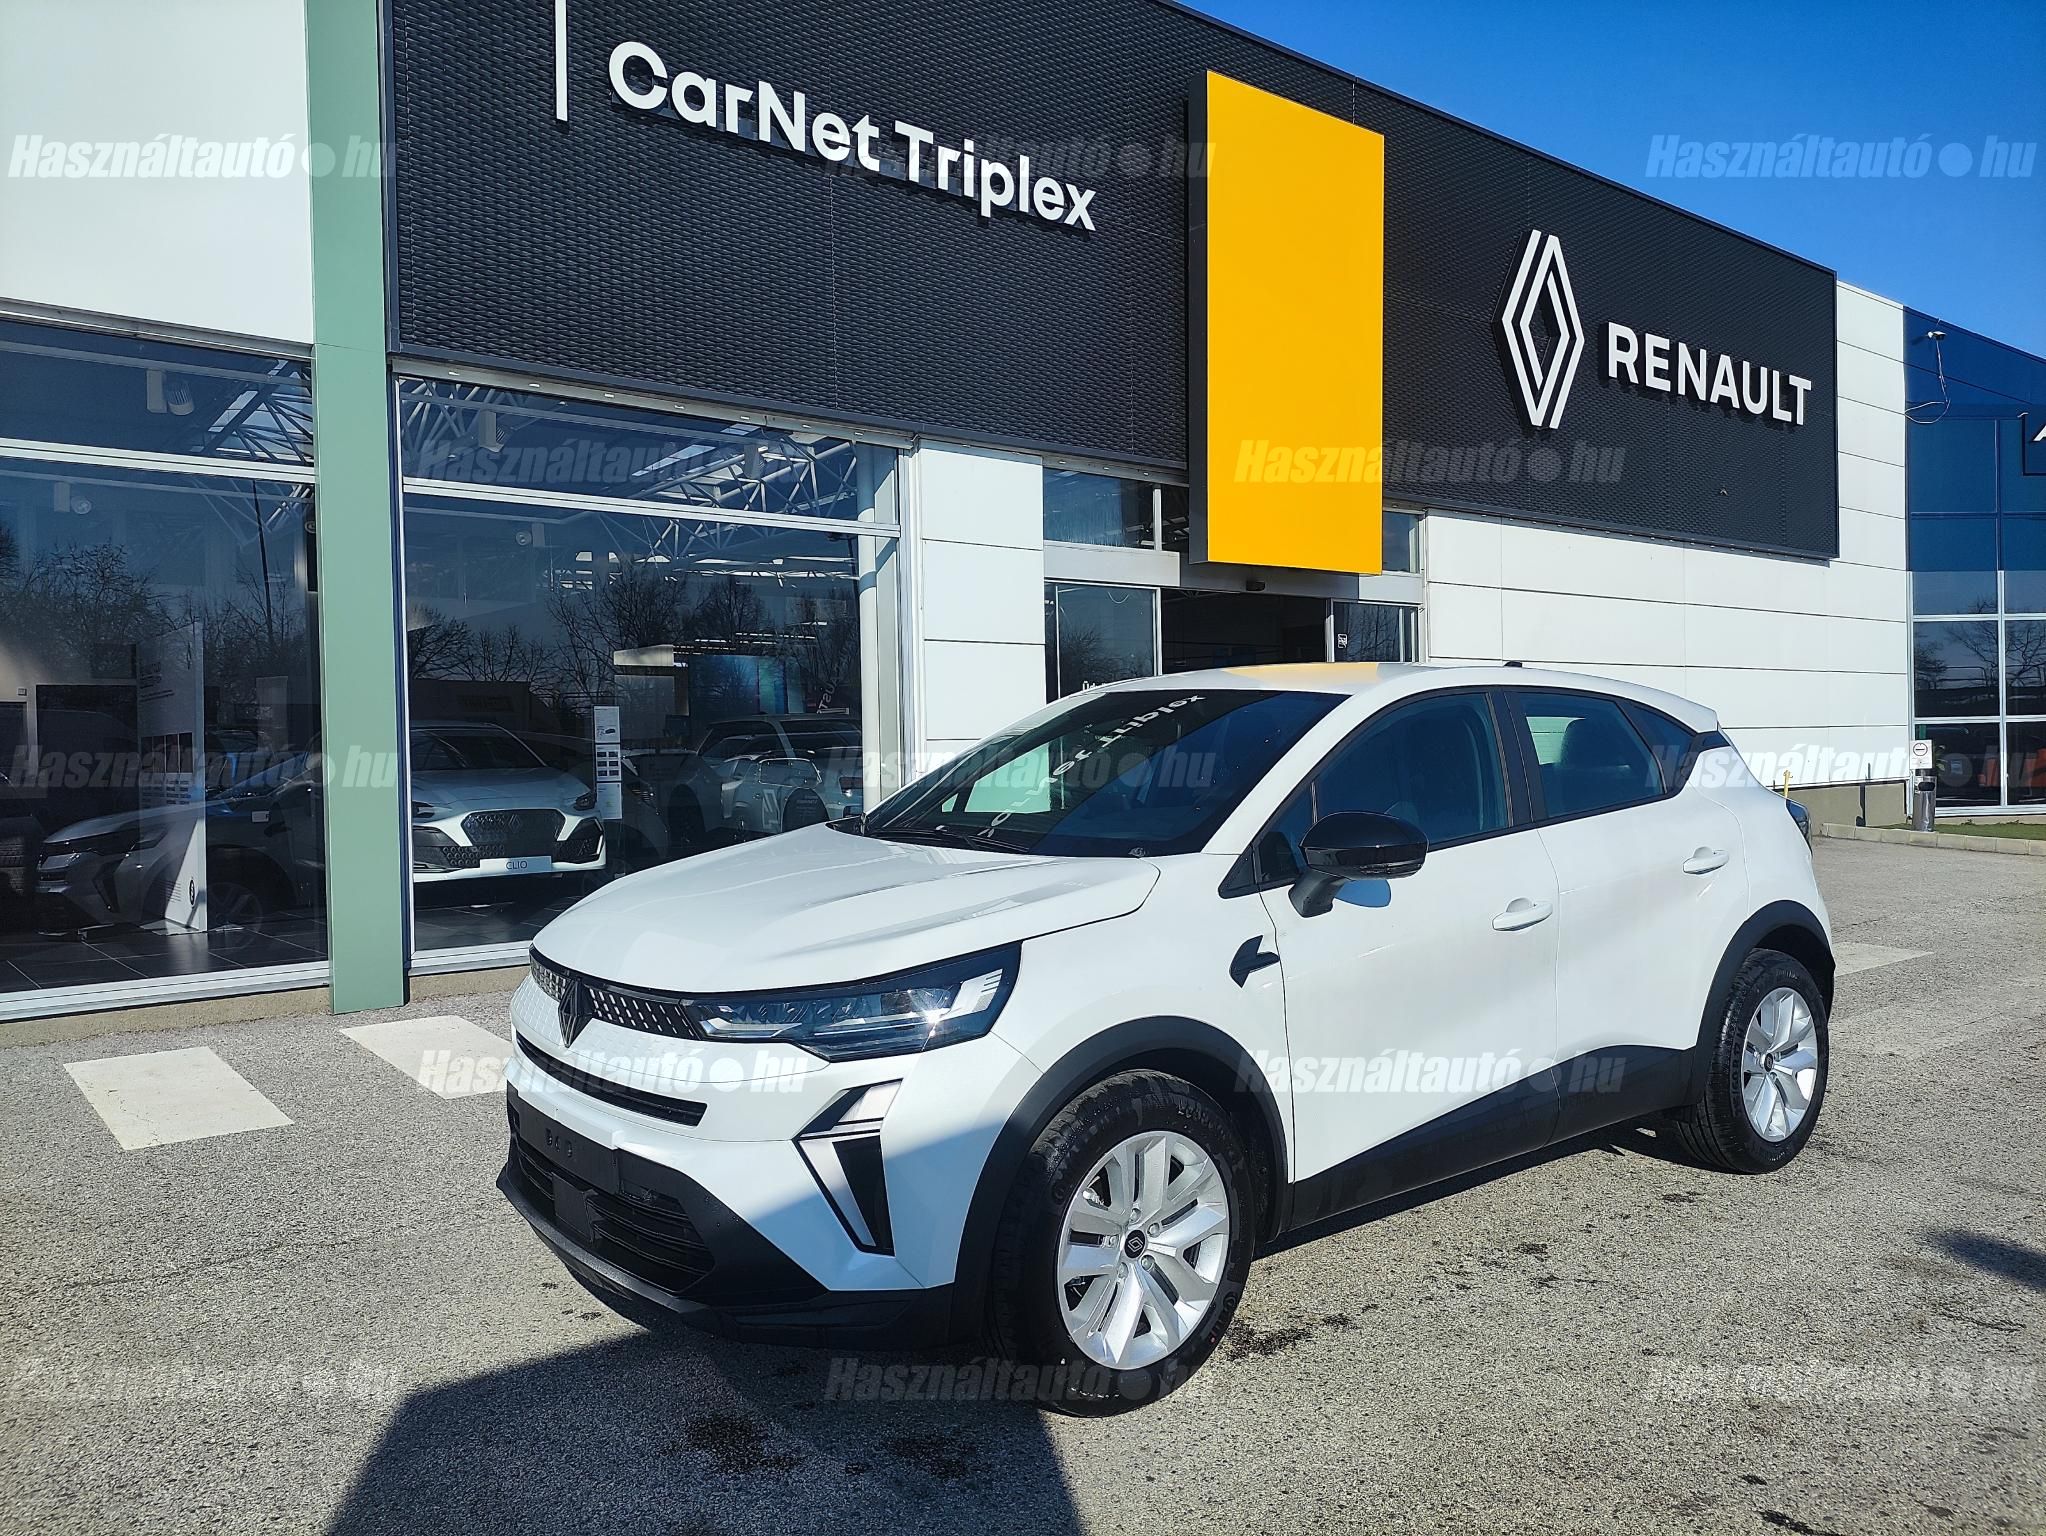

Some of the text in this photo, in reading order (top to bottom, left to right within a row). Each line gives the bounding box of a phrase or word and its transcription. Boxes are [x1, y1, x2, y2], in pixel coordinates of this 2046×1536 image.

[608, 41, 1096, 231] CarNet Triplex
[1608, 322, 1812, 426] RENAULT
[505, 860, 528, 870] CLIO
